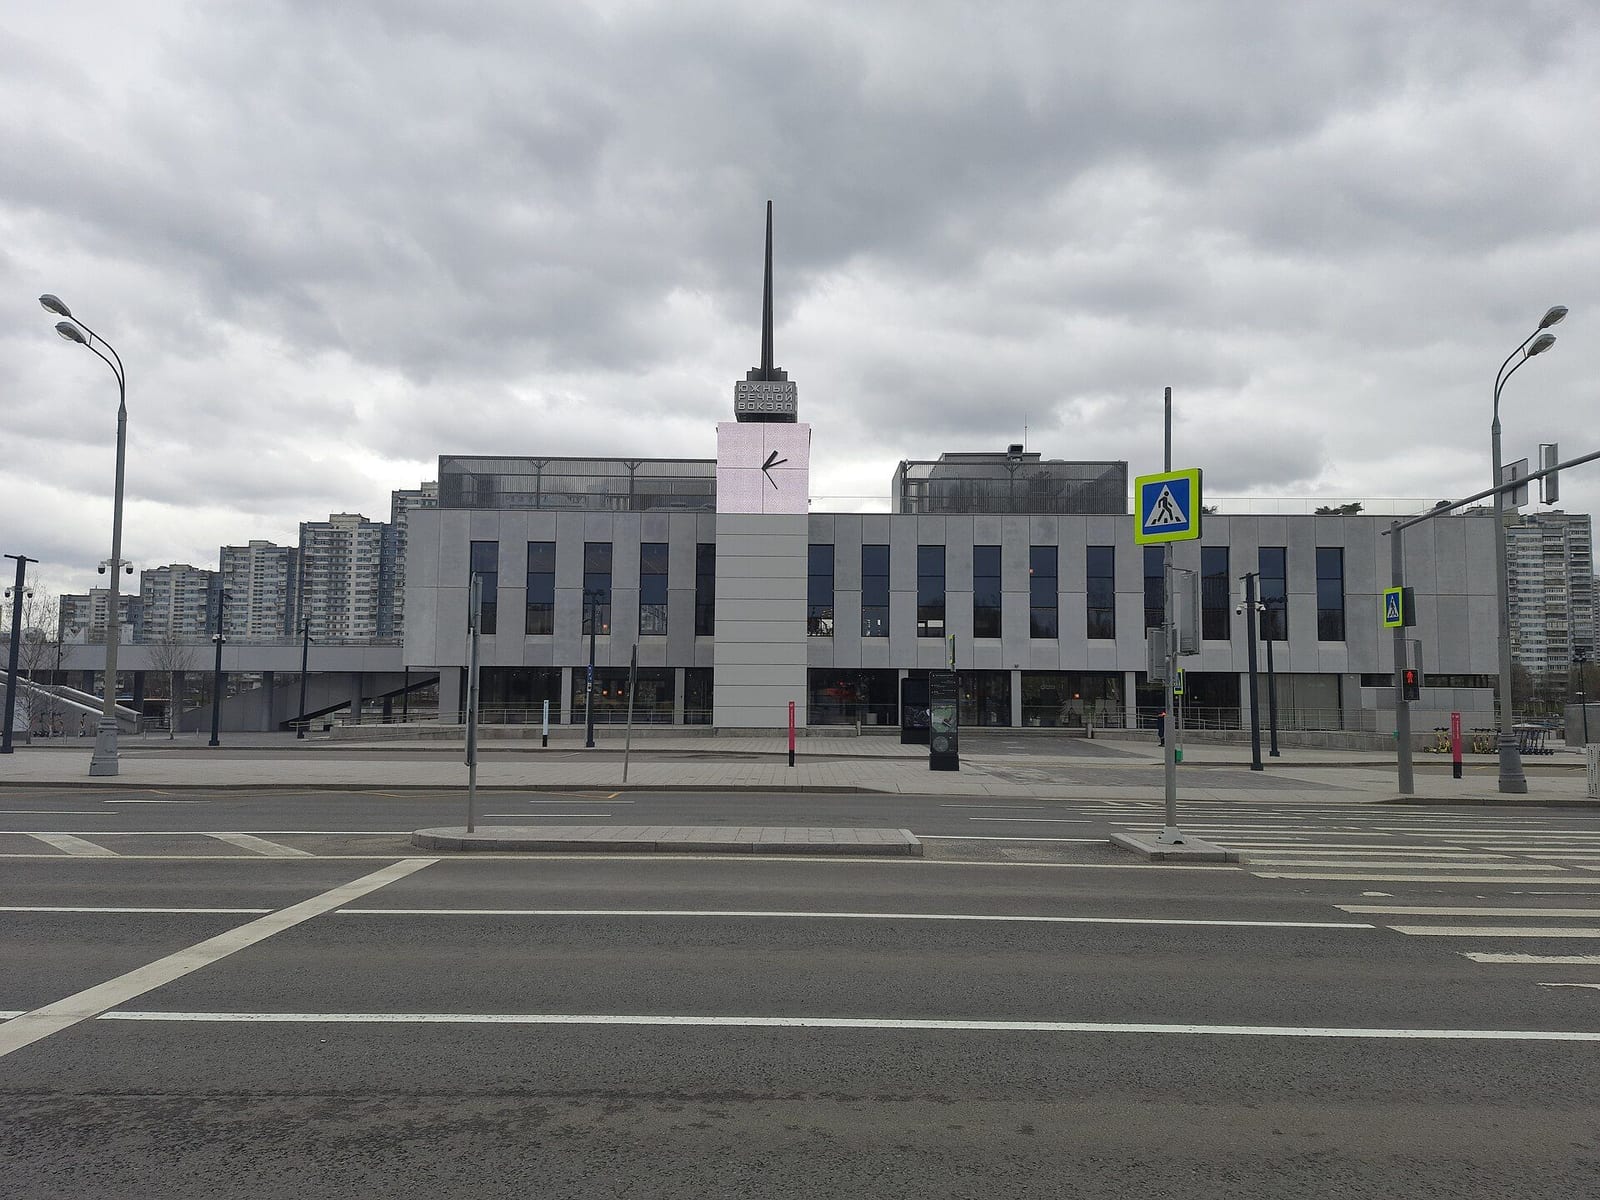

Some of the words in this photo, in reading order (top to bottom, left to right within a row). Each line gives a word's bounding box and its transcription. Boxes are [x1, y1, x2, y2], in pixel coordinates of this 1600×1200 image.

[738, 383, 793, 392] ЮЖНЫЙ
[738, 393, 793, 401] РЕЧНОЙ
[738, 402, 793, 410] ВОКЗАЛ
